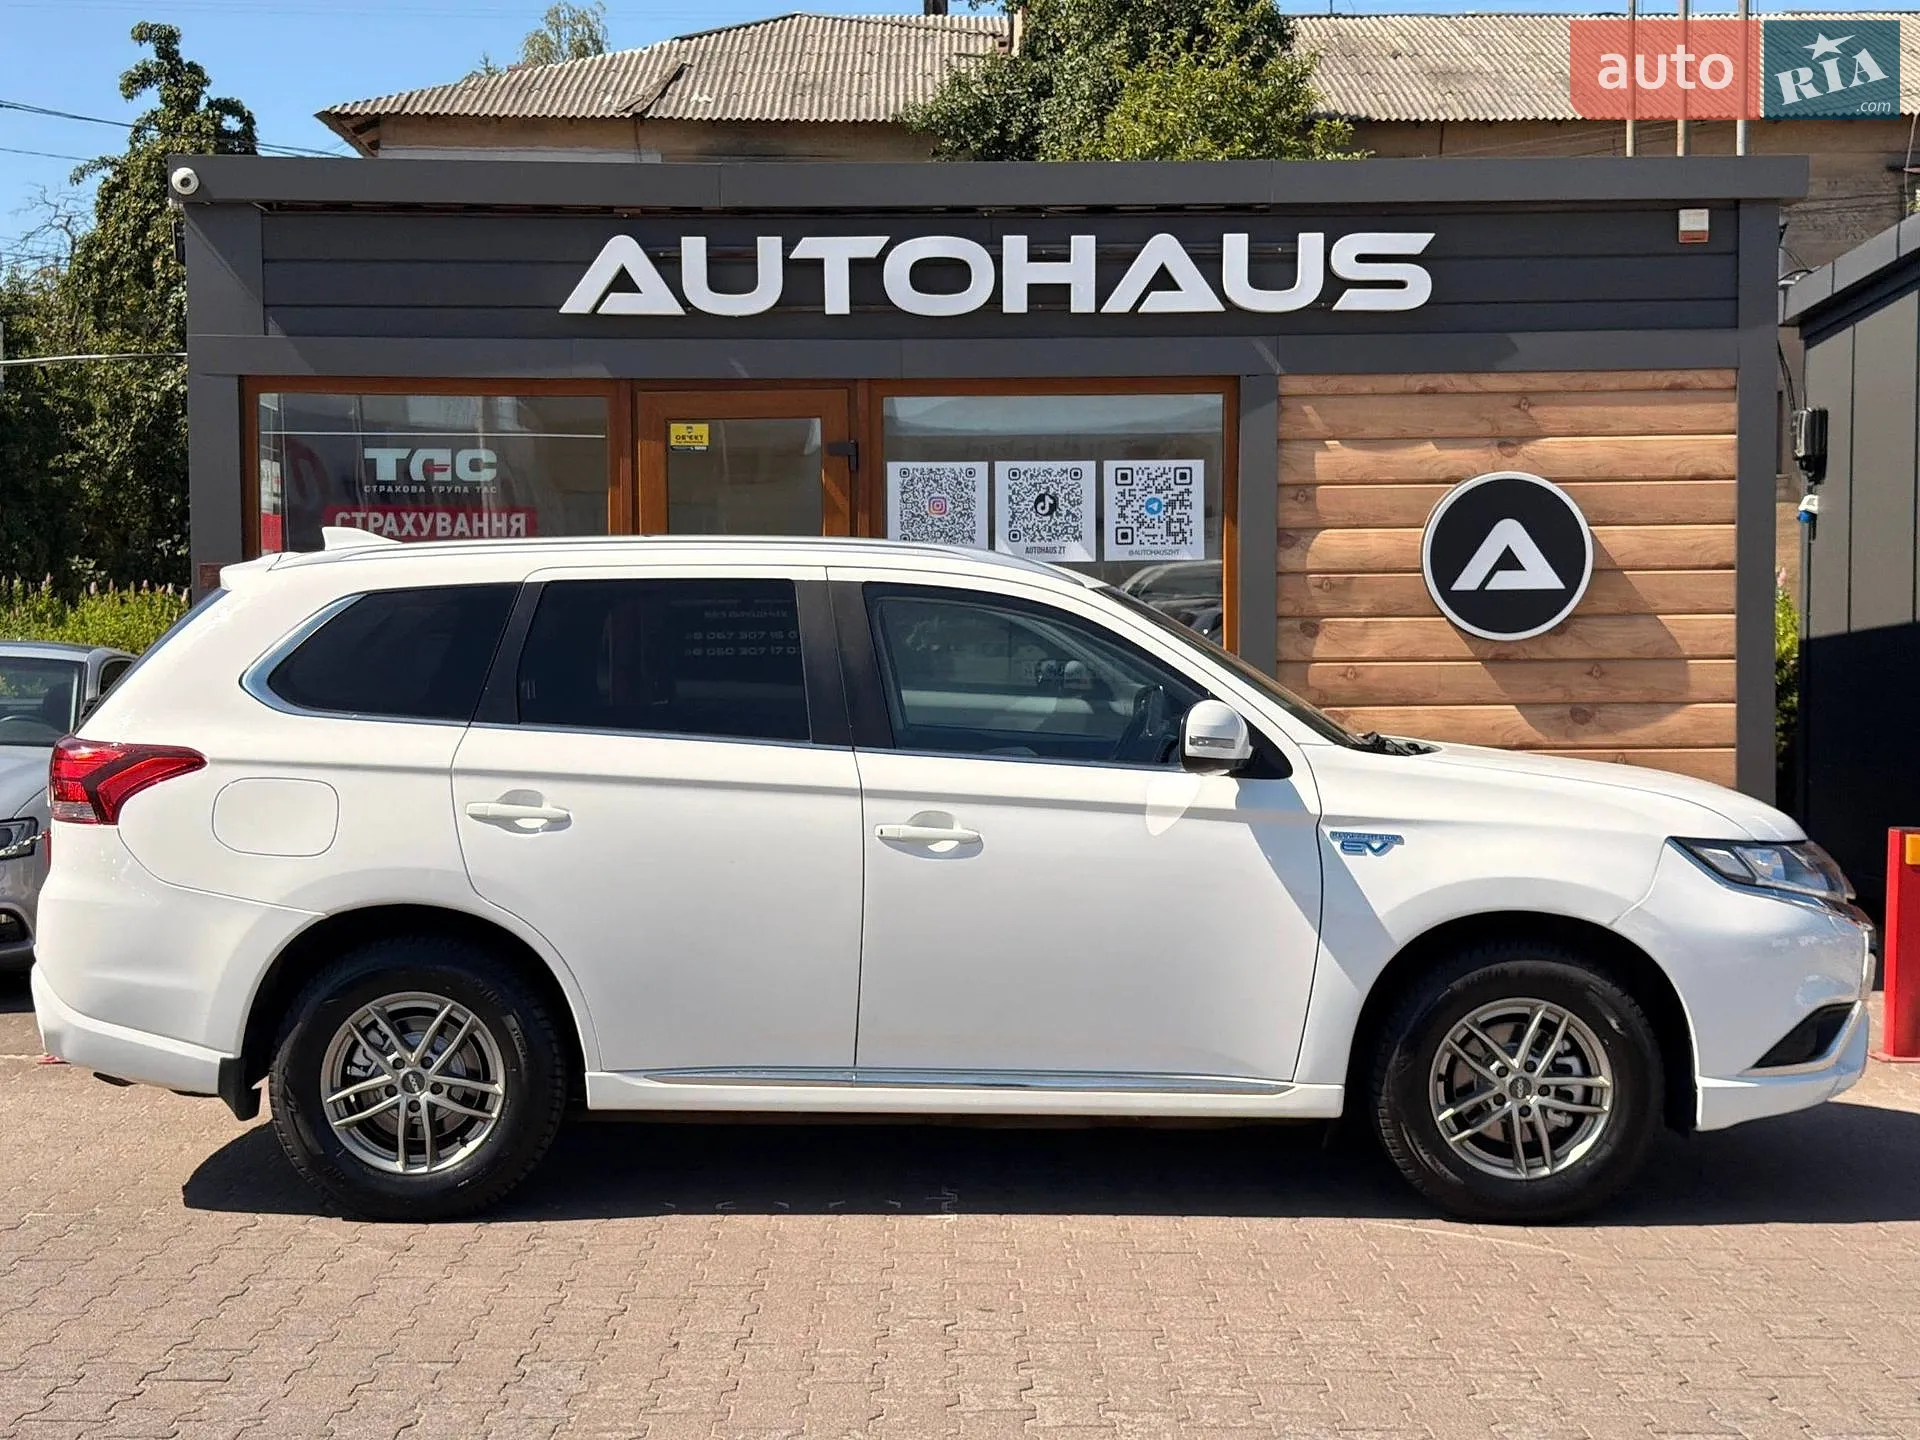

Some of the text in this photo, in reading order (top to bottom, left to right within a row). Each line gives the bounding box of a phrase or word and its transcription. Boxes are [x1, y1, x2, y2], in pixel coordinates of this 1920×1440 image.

[558, 231, 1436, 317] AUTOHAUS
[364, 485, 497, 494] СТРАХОВА ГРУПА ТАС
[335, 511, 526, 538] СТРАХУВАННЯ
[1025, 546, 1057, 555] AUTOHAUS
